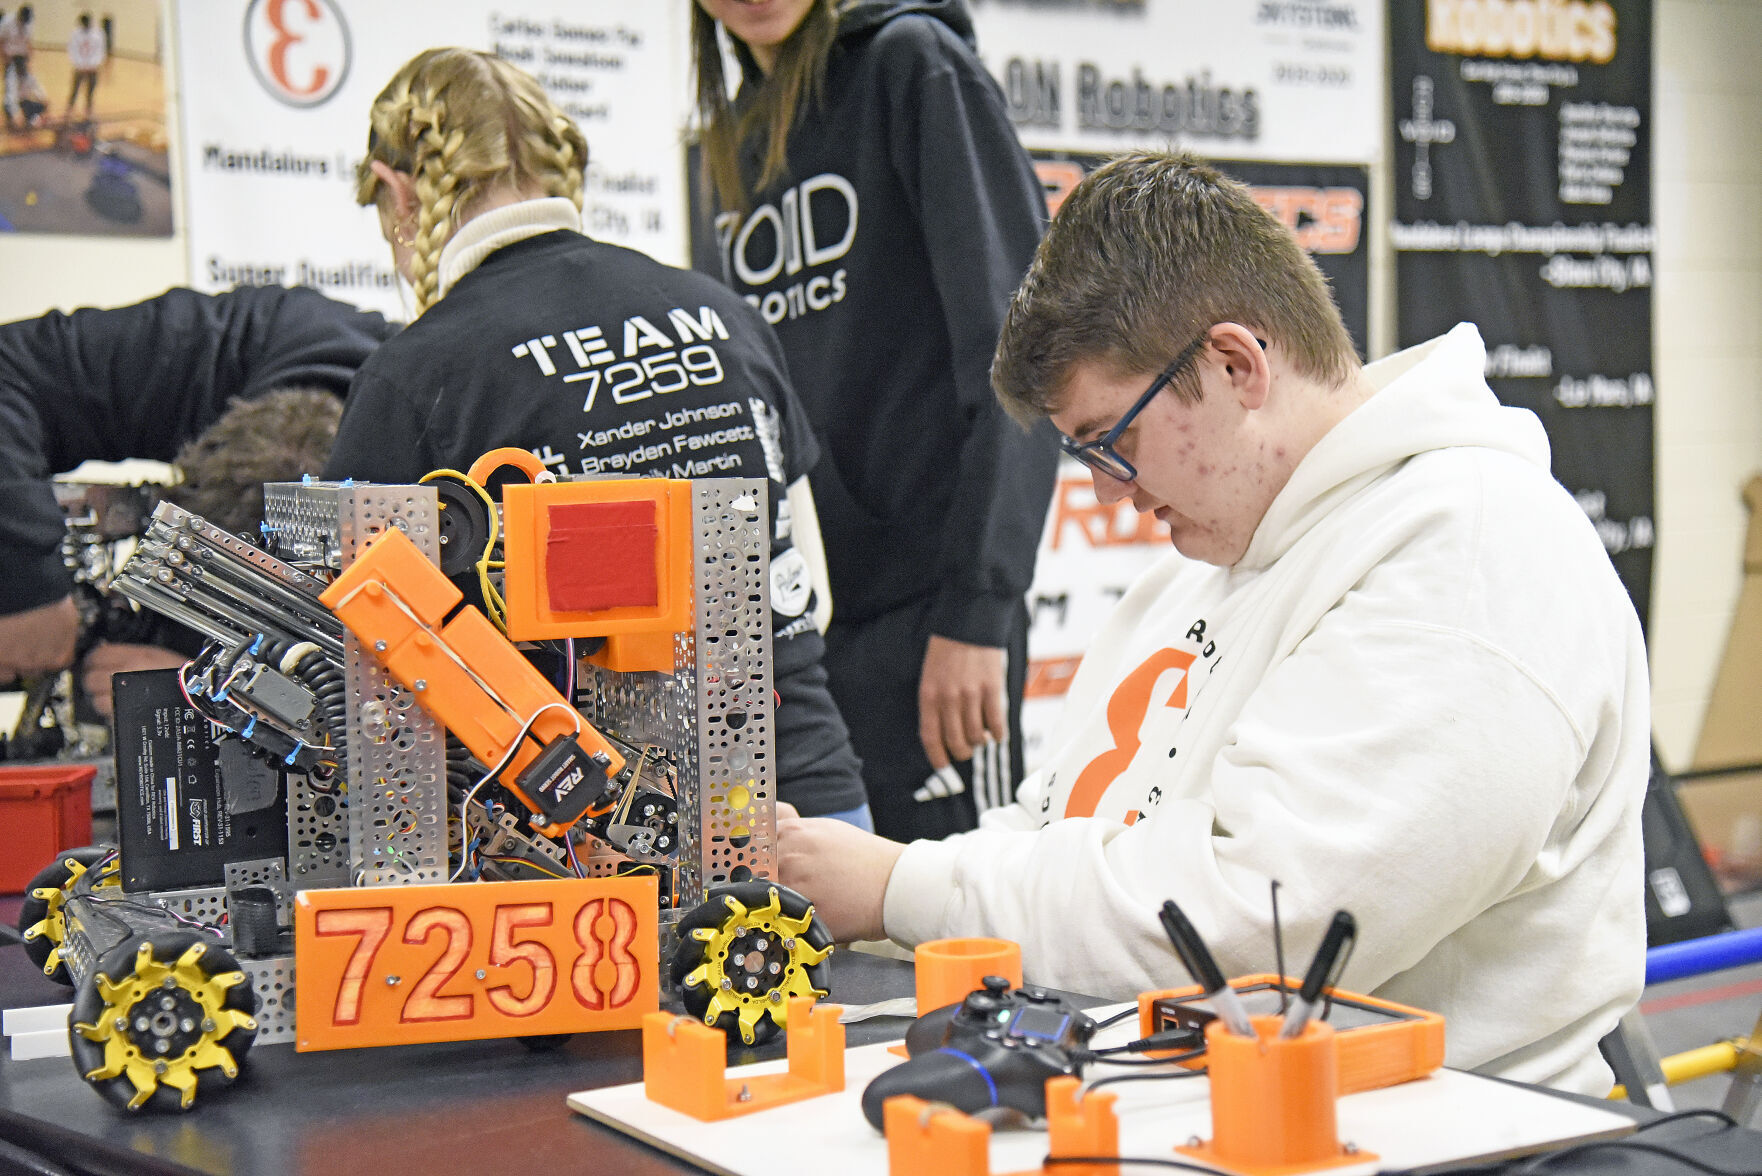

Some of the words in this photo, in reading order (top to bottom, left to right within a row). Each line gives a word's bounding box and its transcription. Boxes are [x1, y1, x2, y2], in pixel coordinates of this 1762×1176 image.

[1075, 63, 1260, 140] Robotics
[511, 305, 730, 376] TEAM
[562, 344, 725, 412] 7259
[577, 418, 657, 450] Xander
[658, 401, 743, 430] Johnson
[580, 442, 673, 474] Brayden
[673, 425, 756, 453] Fawcett
[671, 452, 743, 479] Martin
[555, 767, 585, 803] REV
[192, 817, 201, 846] FIRST
[315, 897, 642, 1028] 7258
